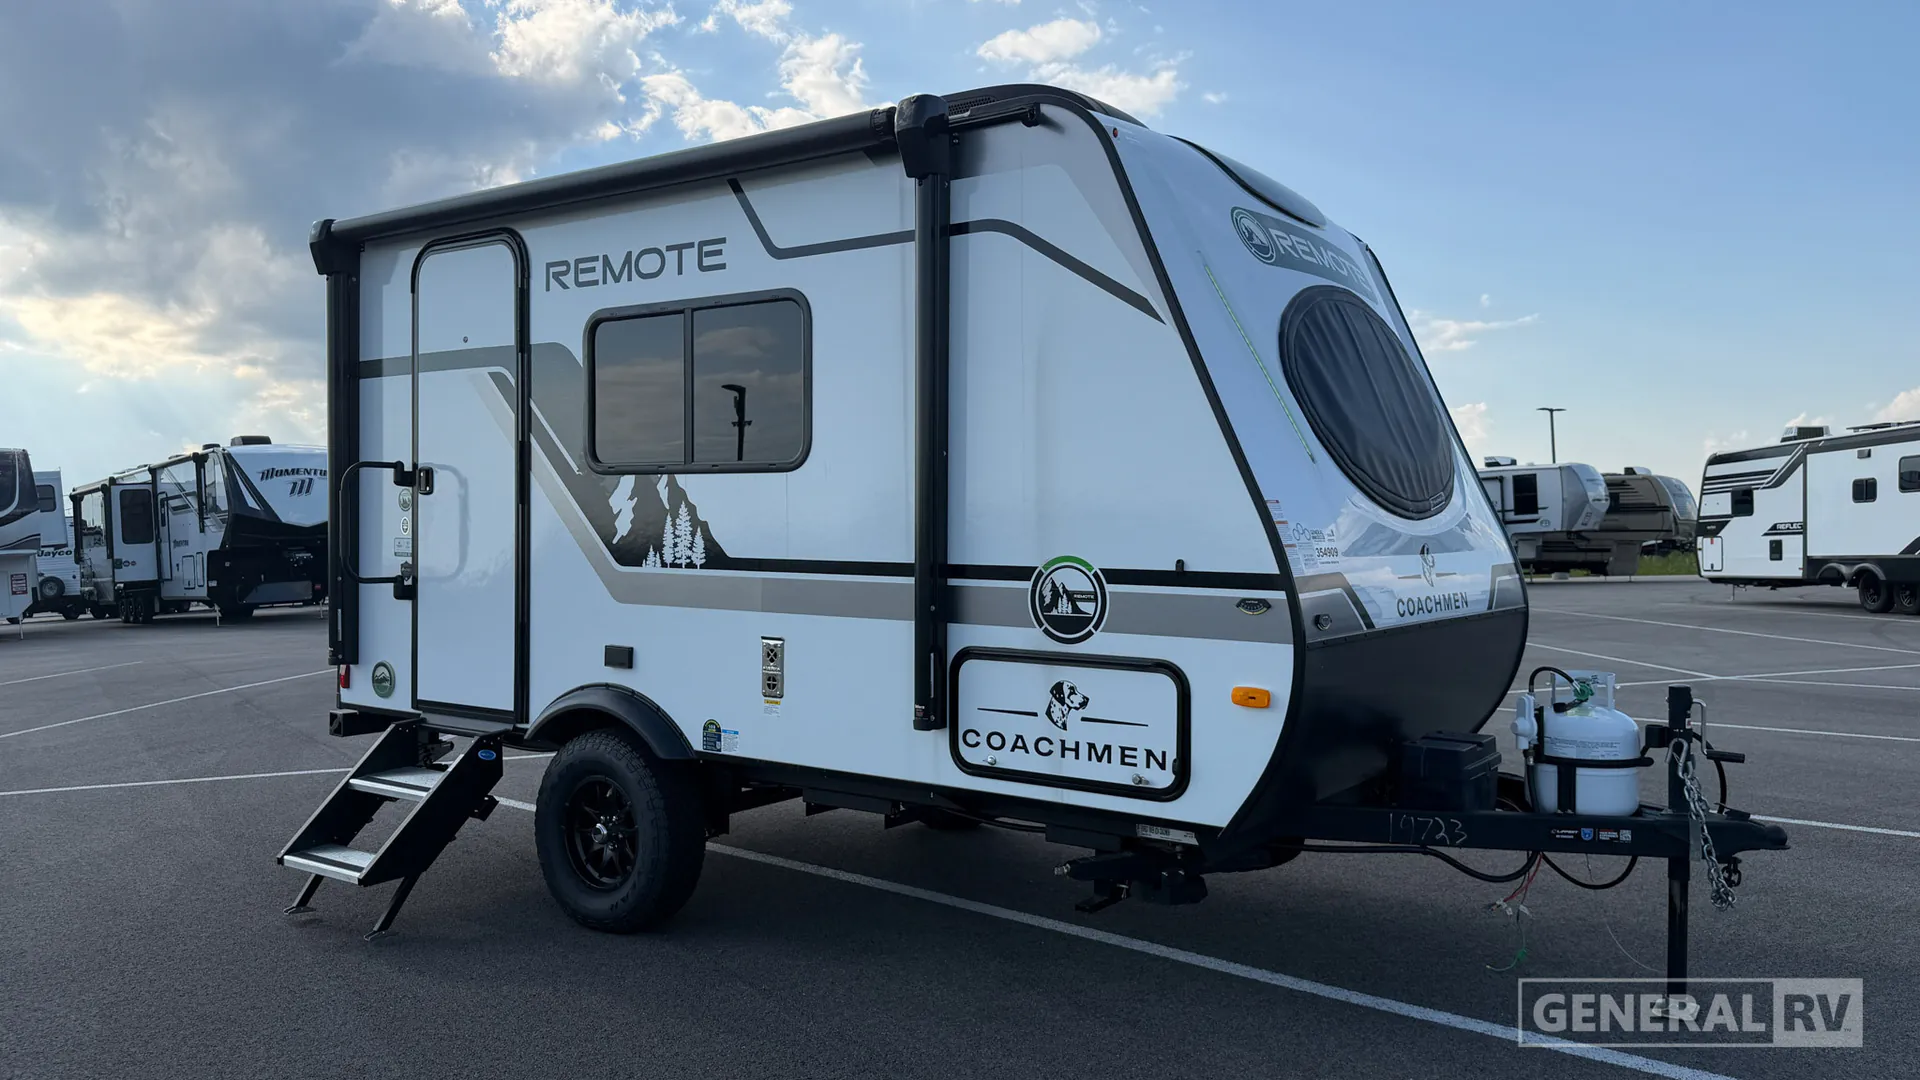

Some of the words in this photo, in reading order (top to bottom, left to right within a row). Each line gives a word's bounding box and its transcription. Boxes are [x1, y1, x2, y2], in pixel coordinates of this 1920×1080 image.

[545, 236, 727, 292] REMOTE
[1268, 228, 1372, 293] REMOTE
[257, 467, 328, 481] MOMENTU
[1776, 522, 1803, 530] REFLEC
[37, 550, 73, 558] Jayco
[1396, 592, 1469, 618] COACHMEN
[961, 728, 1167, 771] COACHMEN
